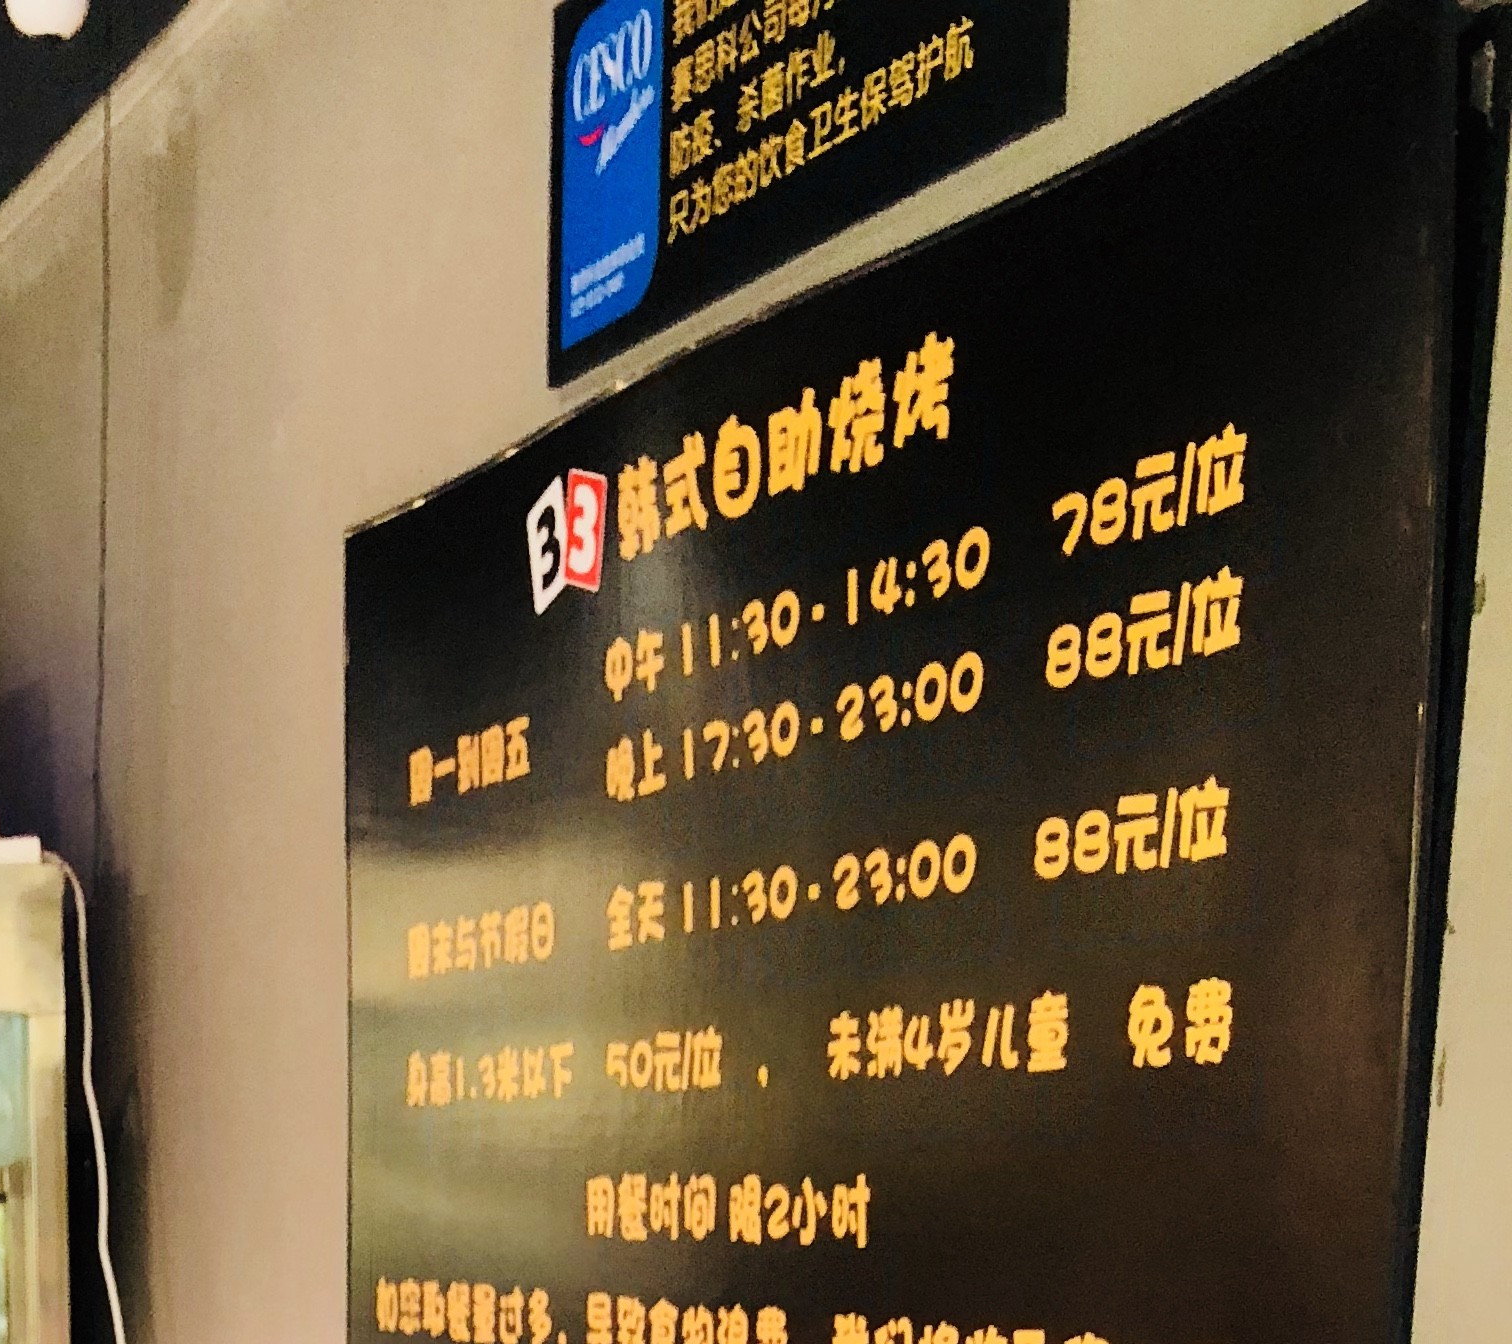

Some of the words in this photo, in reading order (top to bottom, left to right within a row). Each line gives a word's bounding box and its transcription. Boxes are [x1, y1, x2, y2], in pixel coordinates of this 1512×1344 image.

[617, 331, 955, 561] 韩式自助烧烤
[1052, 421, 1248, 557] 78元/位
[1044, 564, 1244, 689] 88元/位
[407, 900, 556, 981] 周末与节假日
[1033, 774, 1231, 880] 88元/位
[406, 1040, 575, 1108] 身高1.3米以下
[826, 990, 1069, 1080] 未满4岁儿童
[1127, 978, 1233, 1069] 免费
